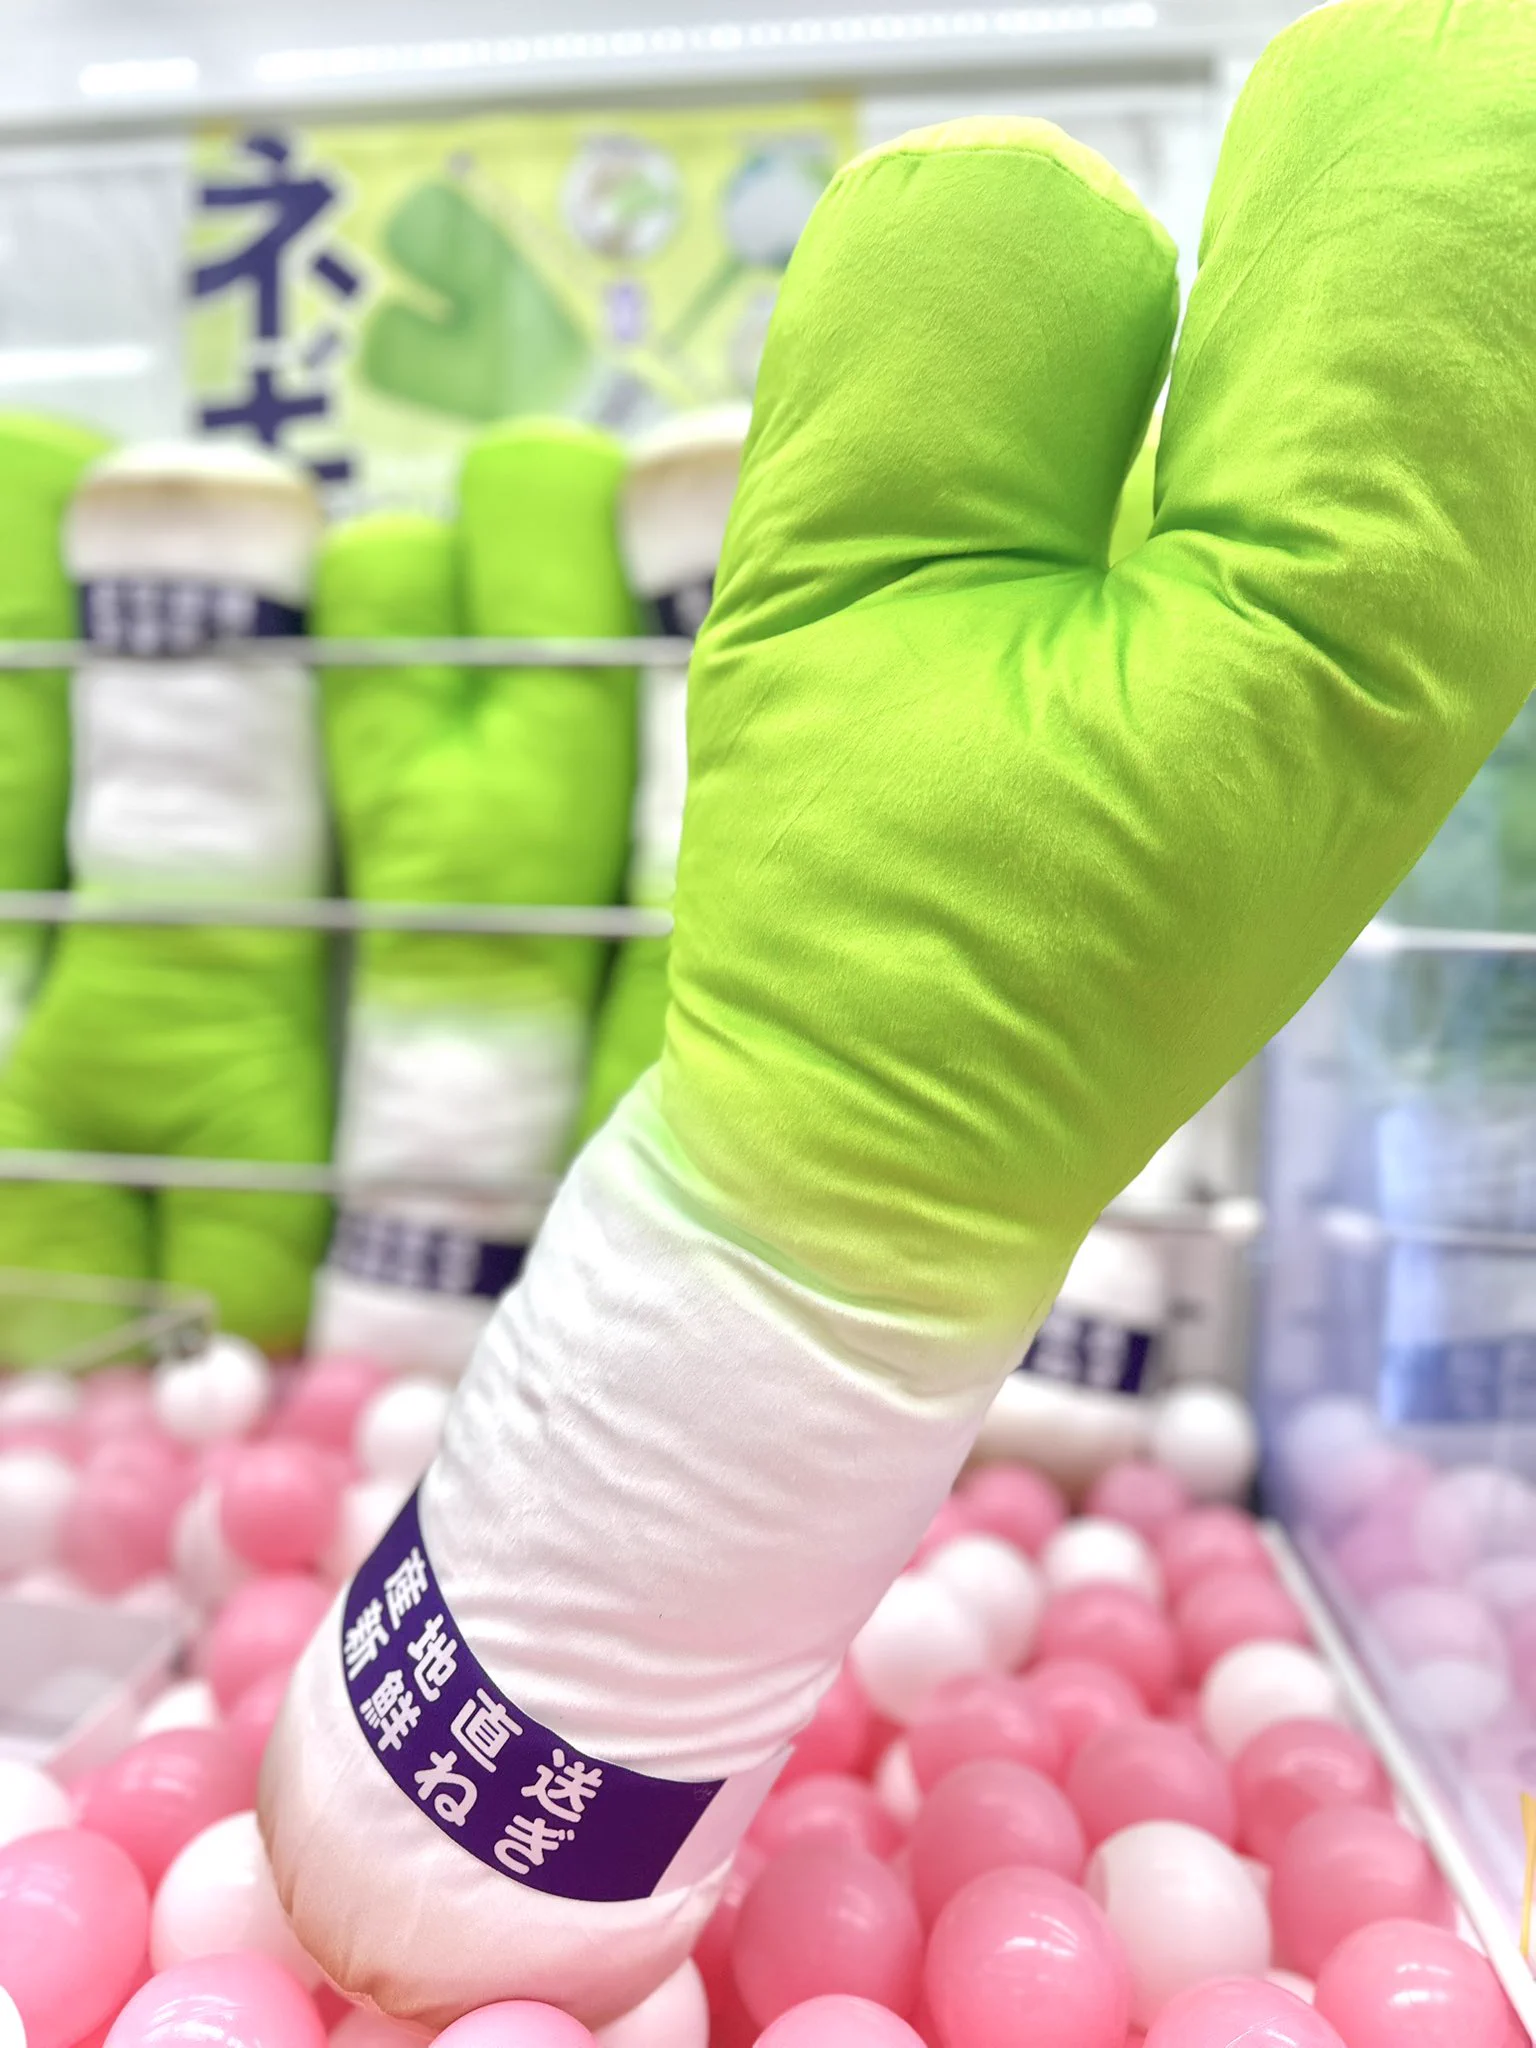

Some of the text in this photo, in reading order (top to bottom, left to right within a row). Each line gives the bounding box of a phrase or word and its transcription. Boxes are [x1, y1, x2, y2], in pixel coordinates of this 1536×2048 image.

[344, 1598, 575, 1875] 新鮮ねぎ
[384, 1547, 602, 1823] 産地直送
